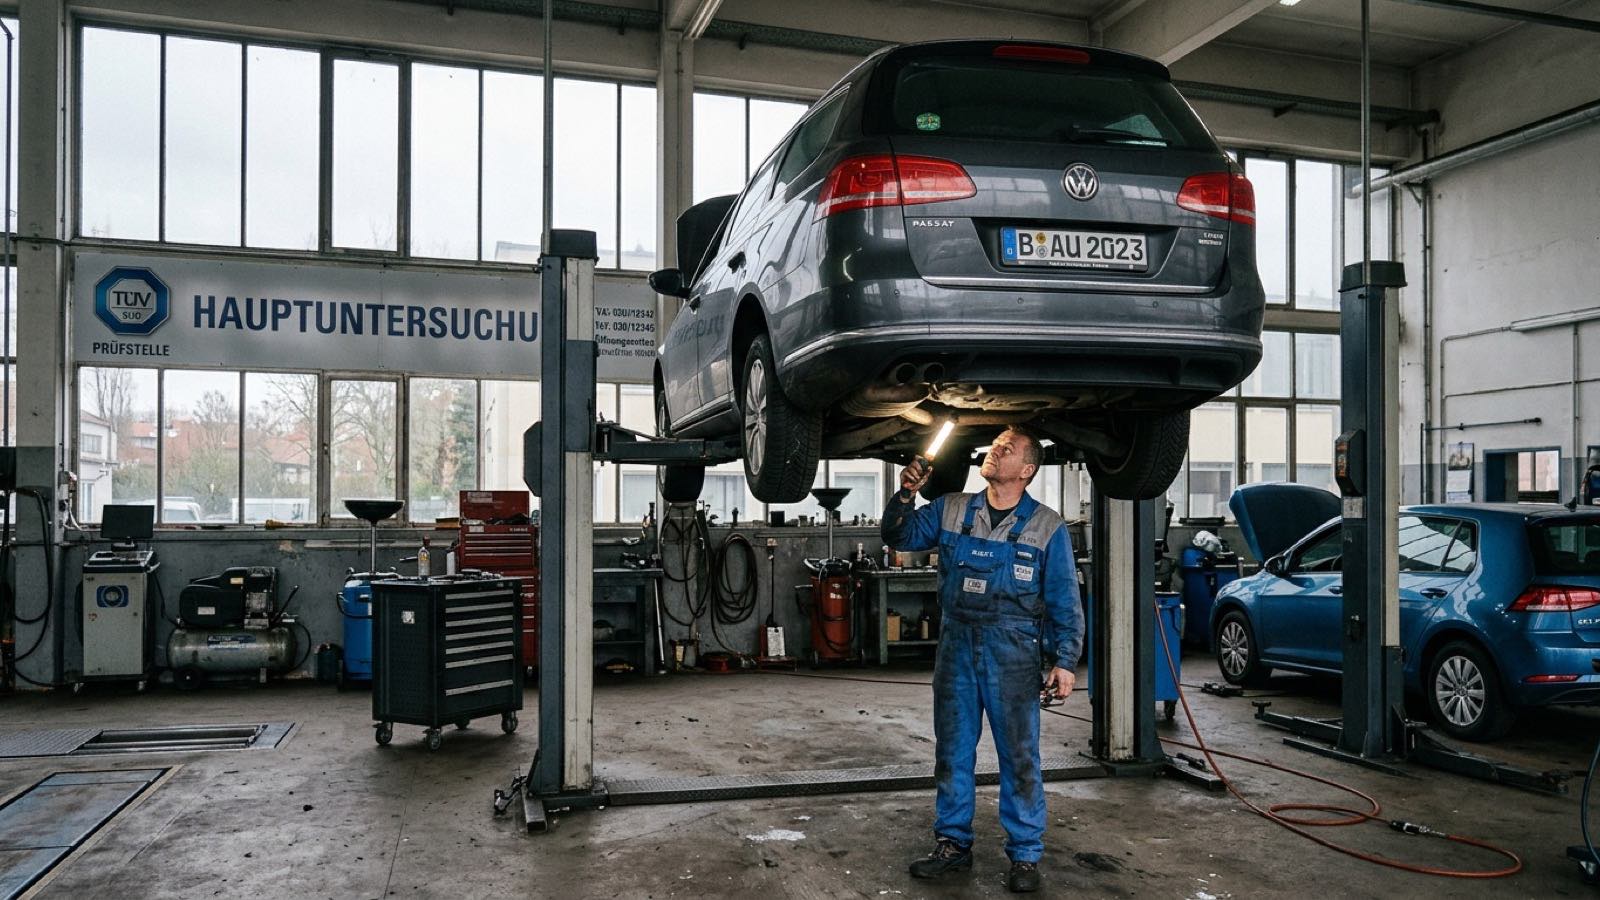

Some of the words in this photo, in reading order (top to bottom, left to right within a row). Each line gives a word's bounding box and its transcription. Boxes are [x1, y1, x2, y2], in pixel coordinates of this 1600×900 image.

[1018, 233, 1034, 256] B
[1050, 234, 1081, 258] AU
[1086, 236, 1144, 261] 2023
[92, 340, 170, 356] PRÜFSTELLE
